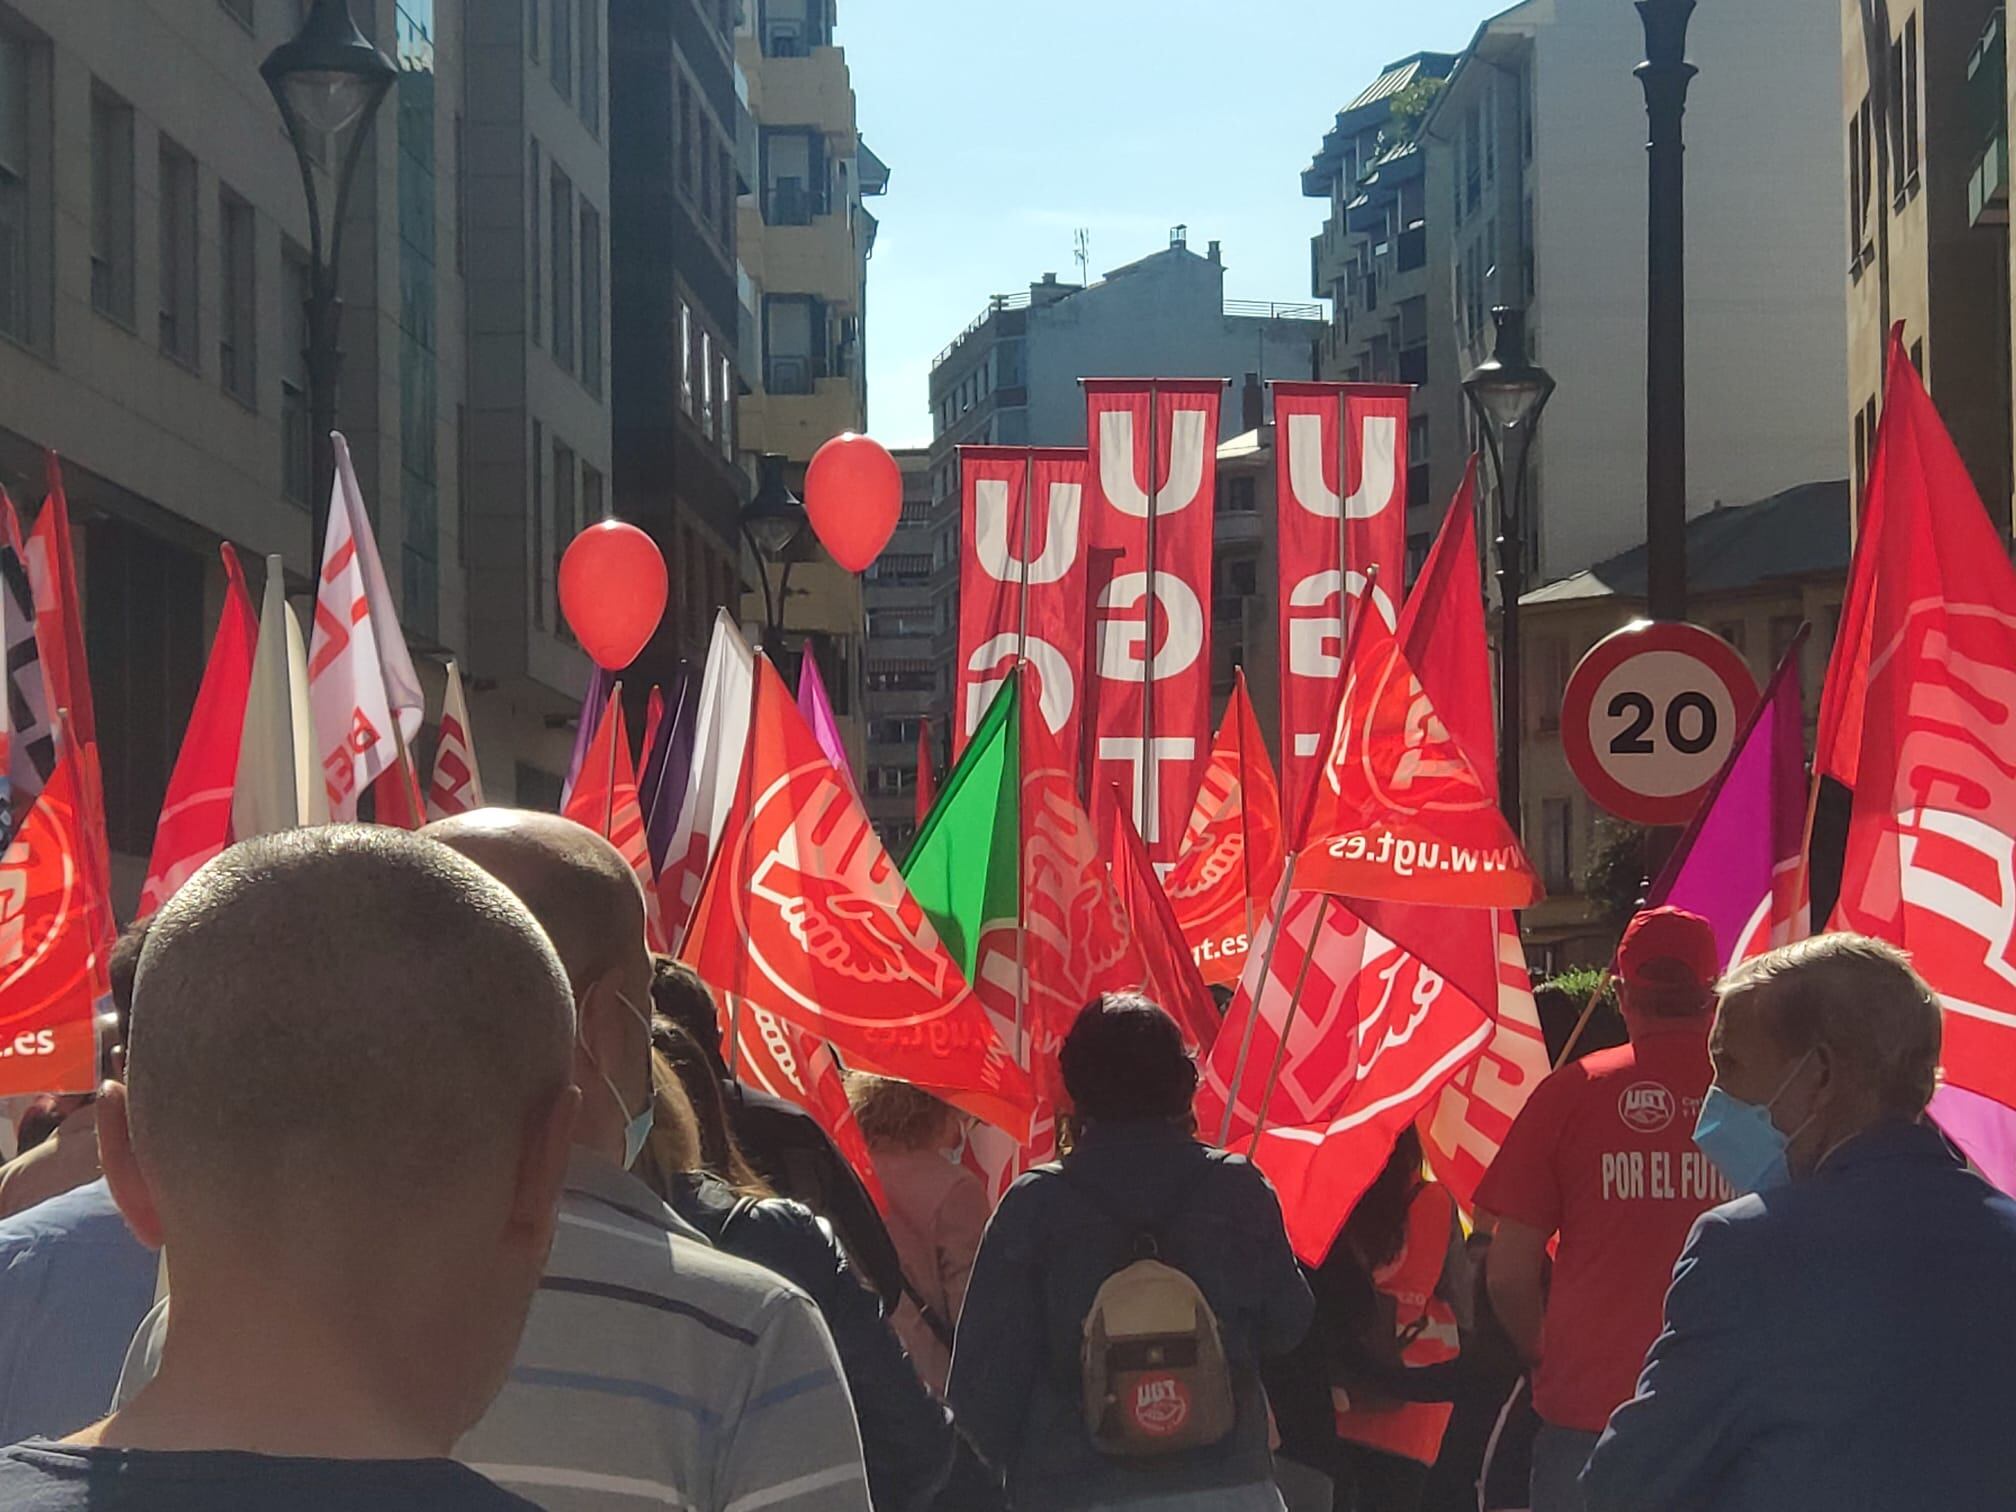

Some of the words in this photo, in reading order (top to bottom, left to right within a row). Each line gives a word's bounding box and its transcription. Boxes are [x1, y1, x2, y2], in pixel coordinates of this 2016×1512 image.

[1607, 691, 1718, 755] 20
[1624, 1089, 1667, 1118] UGT
[1602, 1151, 1644, 1201] POR
[1650, 1151, 1675, 1199] EL
[1681, 1152, 1737, 1201] FUTU
